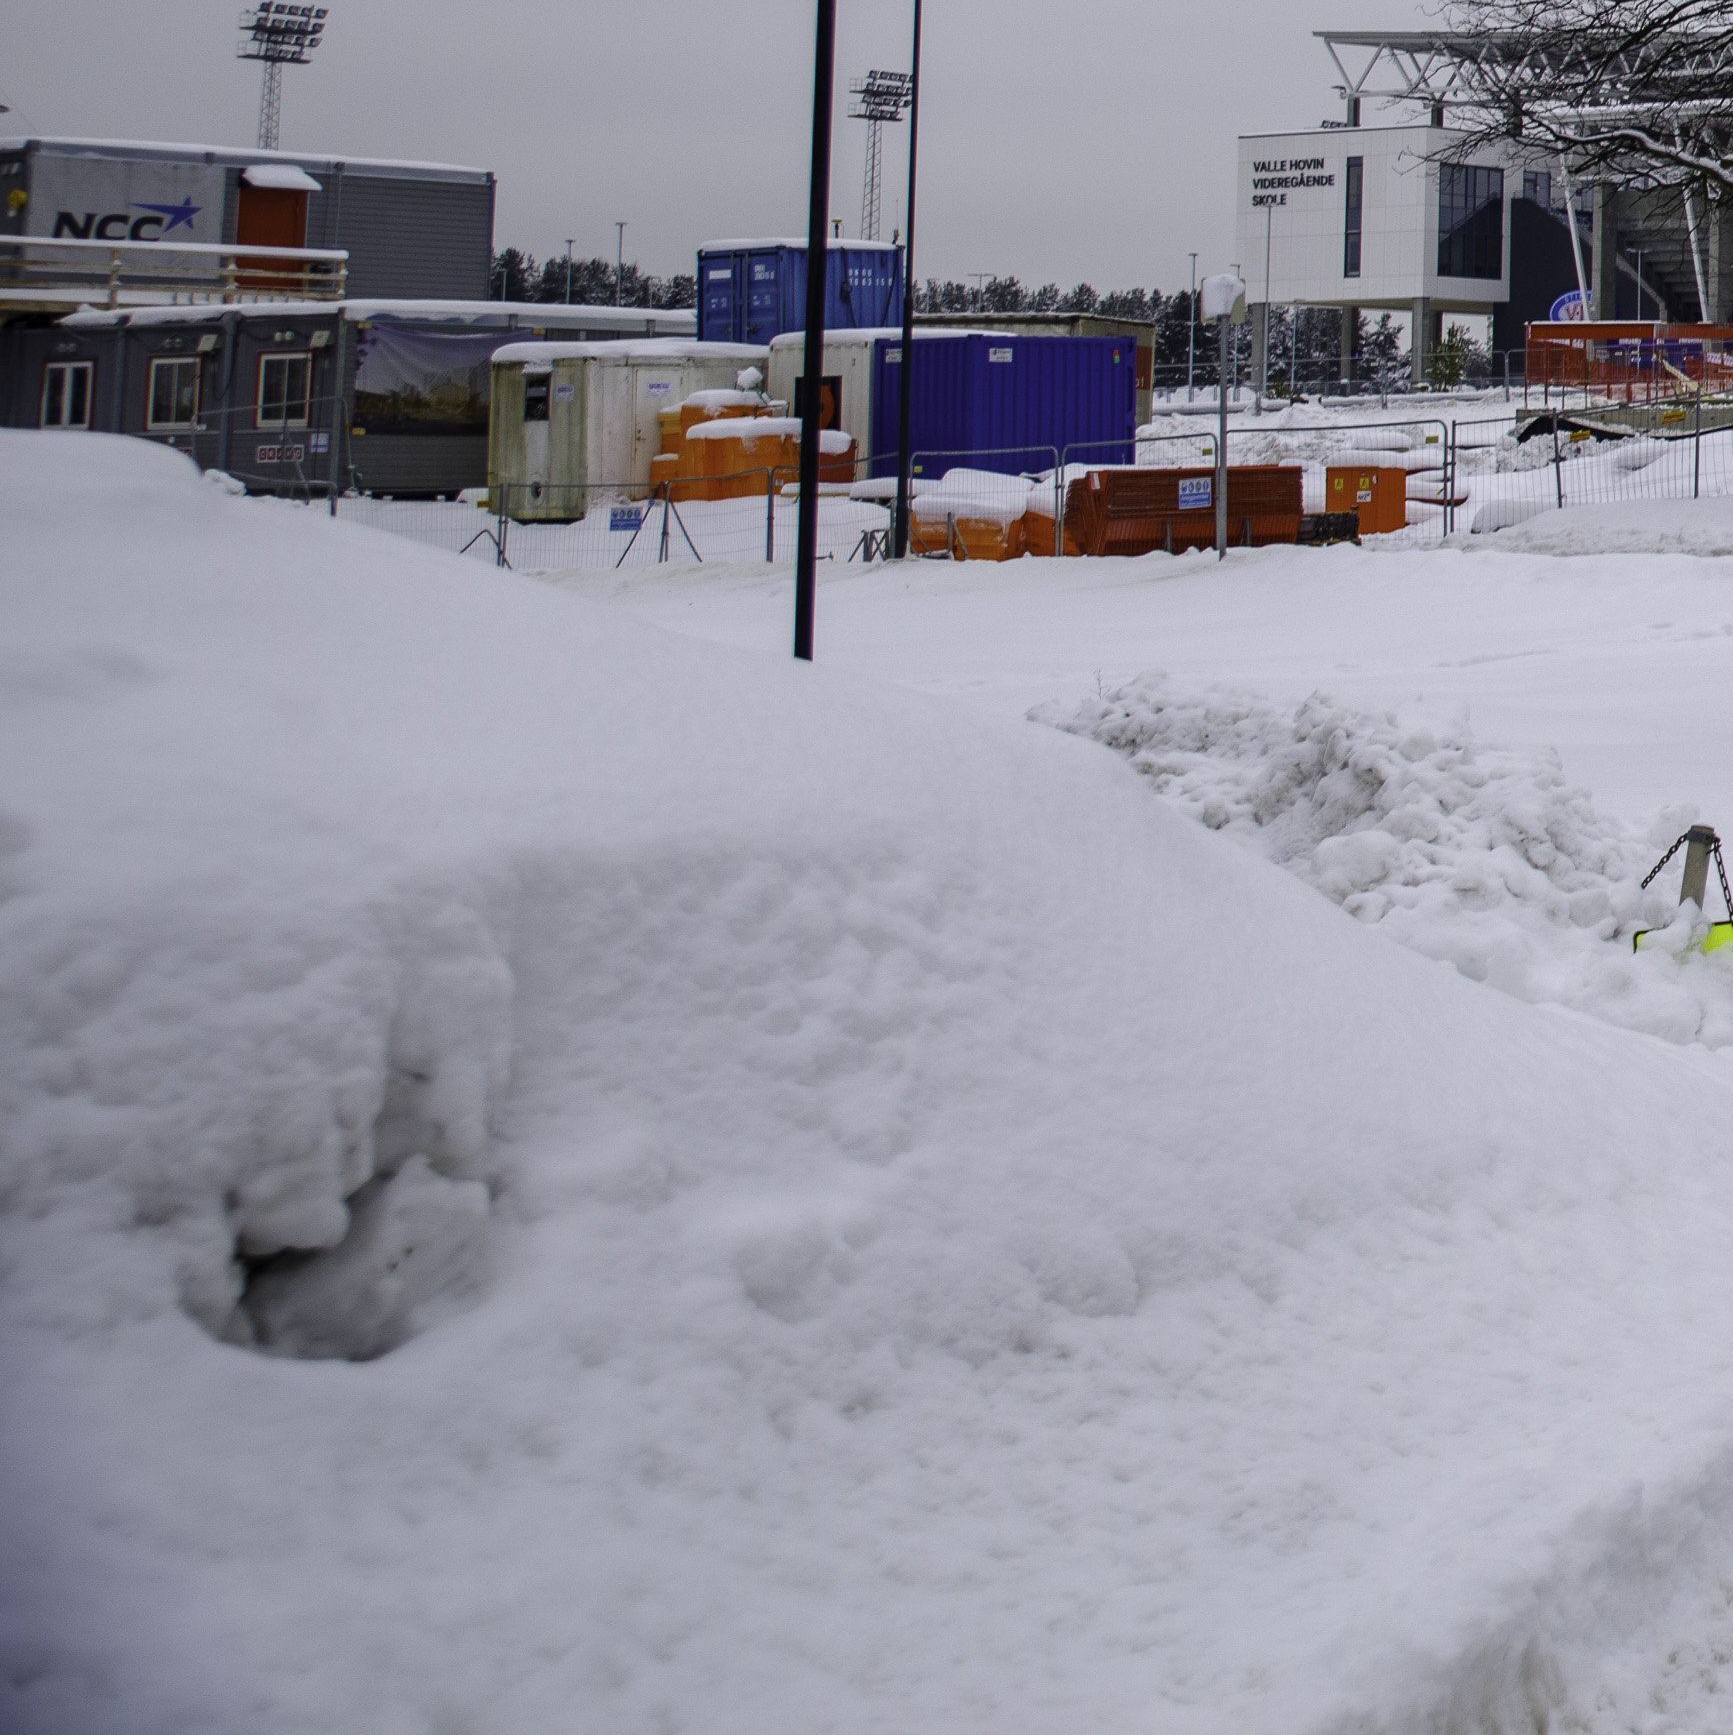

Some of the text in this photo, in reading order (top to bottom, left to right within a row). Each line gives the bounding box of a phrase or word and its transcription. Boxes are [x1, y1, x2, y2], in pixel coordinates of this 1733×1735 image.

[1252, 158, 1325, 173] VALLE HOVIN
[1252, 173, 1335, 189] VIDEREGÅENDE
[1252, 194, 1287, 206] SKOLE
[53, 211, 165, 242] NCC
